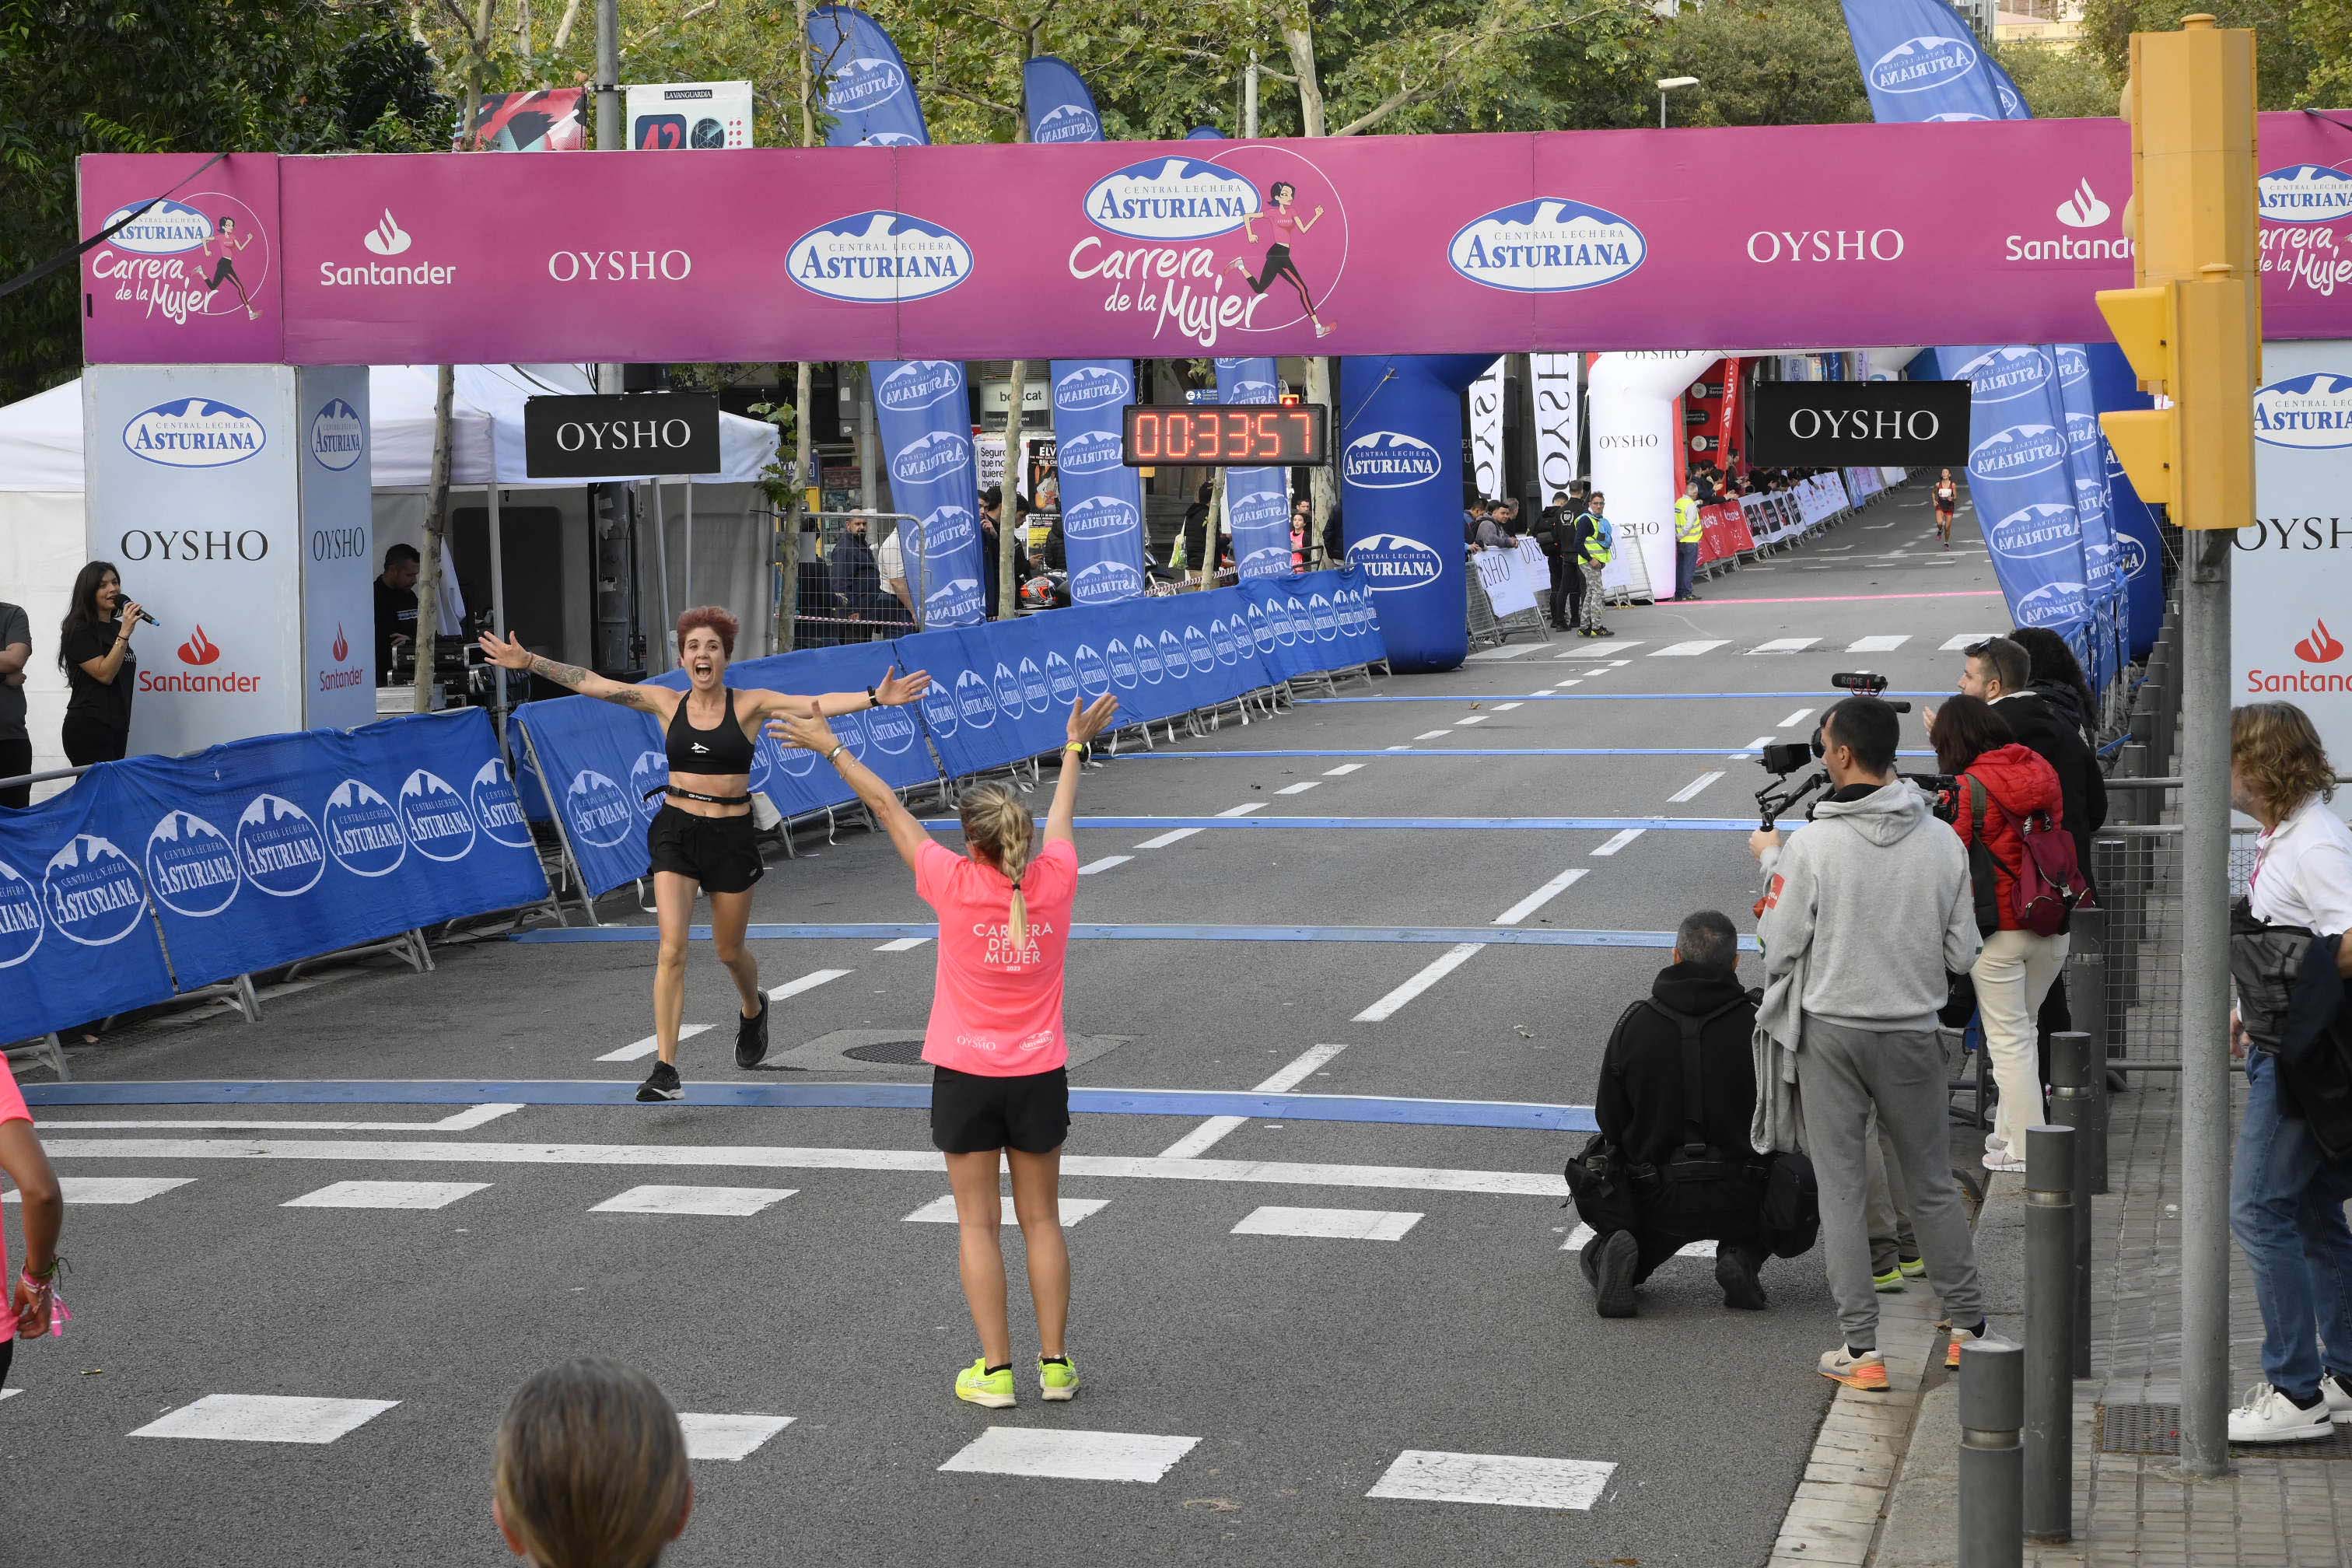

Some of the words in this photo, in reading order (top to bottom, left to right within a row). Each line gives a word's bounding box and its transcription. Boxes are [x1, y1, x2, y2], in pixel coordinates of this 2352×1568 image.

[1124, 186, 1179, 194] CENTRAL
[1185, 184, 1242, 194] LECHERA
[1097, 187, 1246, 219] ASTURIANA
[112, 219, 205, 240] ASTURIANA
[1494, 231, 1555, 241] CENTRAL
[1562, 229, 1624, 239] LECHERA
[2259, 227, 2333, 250] arrera
[829, 243, 888, 252] CENTRAL
[892, 242, 953, 251] LECHERA
[1069, 236, 1214, 280] Carrera
[1464, 234, 1631, 269] ASTURIANA
[1747, 229, 1905, 263] OYSHO
[92, 250, 185, 279] Carrera
[548, 249, 692, 282] OYSHO
[800, 245, 959, 279] ASTURIANA
[2277, 250, 2291, 271] la
[320, 261, 457, 287] Santander
[115, 281, 132, 300] de
[136, 278, 148, 300] la
[145, 277, 219, 325] Mujer
[1104, 282, 1132, 312] de
[1138, 280, 1157, 312] la
[1152, 275, 1269, 348] Mujer
[999, 390, 1042, 402] b.cat
[2275, 399, 2328, 408] CENTRAL
[134, 424, 256, 450] ASTURIANA
[556, 418, 691, 452] OYSHO
[1136, 413, 1310, 457] 00:33:57
[1789, 408, 1940, 441] OYSHO
[315, 425, 360, 453] ASTURIANA
[1599, 434, 1658, 450] OYSHO
[982, 460, 994, 468] que
[1346, 454, 1434, 476] ASTURIANA
[1622, 521, 1660, 536] SHO
[121, 530, 269, 562] OYSHO
[313, 527, 365, 562] OYSHO
[1349, 556, 1435, 577] ATURIANA
[138, 670, 261, 693] Santander
[320, 665, 363, 692] Santander
[406, 807, 472, 842] ASTURIANA
[574, 800, 629, 835] ASTRIANA
[252, 829, 281, 843] CENTRAL
[282, 823, 310, 838] LECHERA
[332, 818, 403, 856] ASTURIANA
[164, 847, 194, 861] CENTRAL
[244, 837, 322, 877] ASTURIANA
[61, 871, 94, 887] CENTRAL
[156, 856, 236, 895] ASTURIANA
[973, 922, 1054, 938] CARERA
[983, 950, 1041, 964] MUJER
[988, 938, 1011, 951] DE
